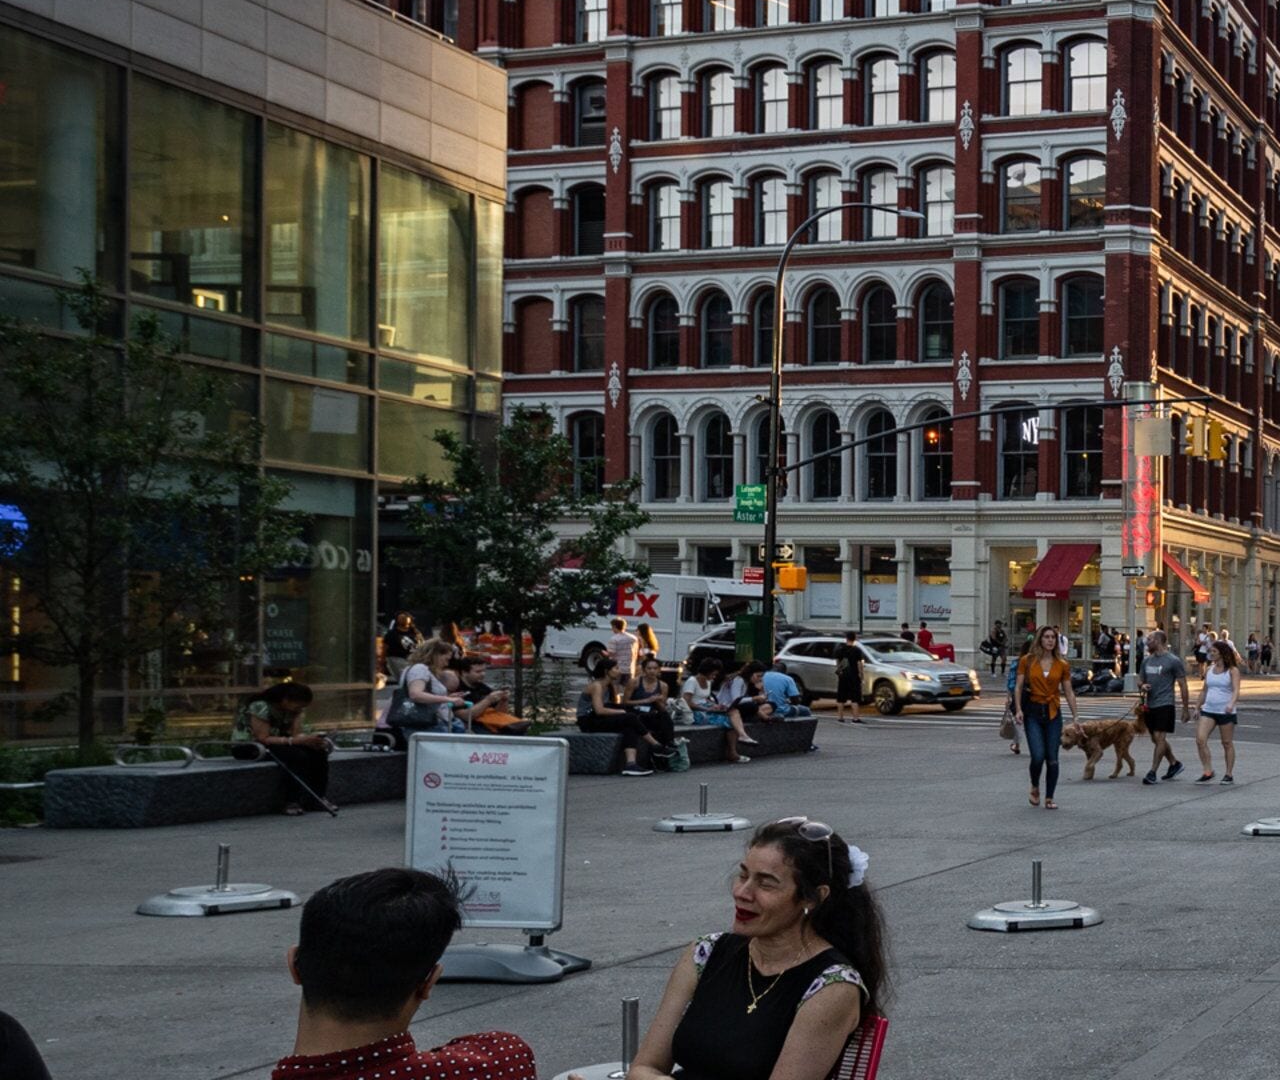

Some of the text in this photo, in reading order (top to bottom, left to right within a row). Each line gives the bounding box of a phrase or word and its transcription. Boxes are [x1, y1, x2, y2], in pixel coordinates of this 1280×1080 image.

[736, 511, 757, 522] Astor
[266, 629, 295, 638] CHASE
[266, 640, 303, 650] PRIVATE
